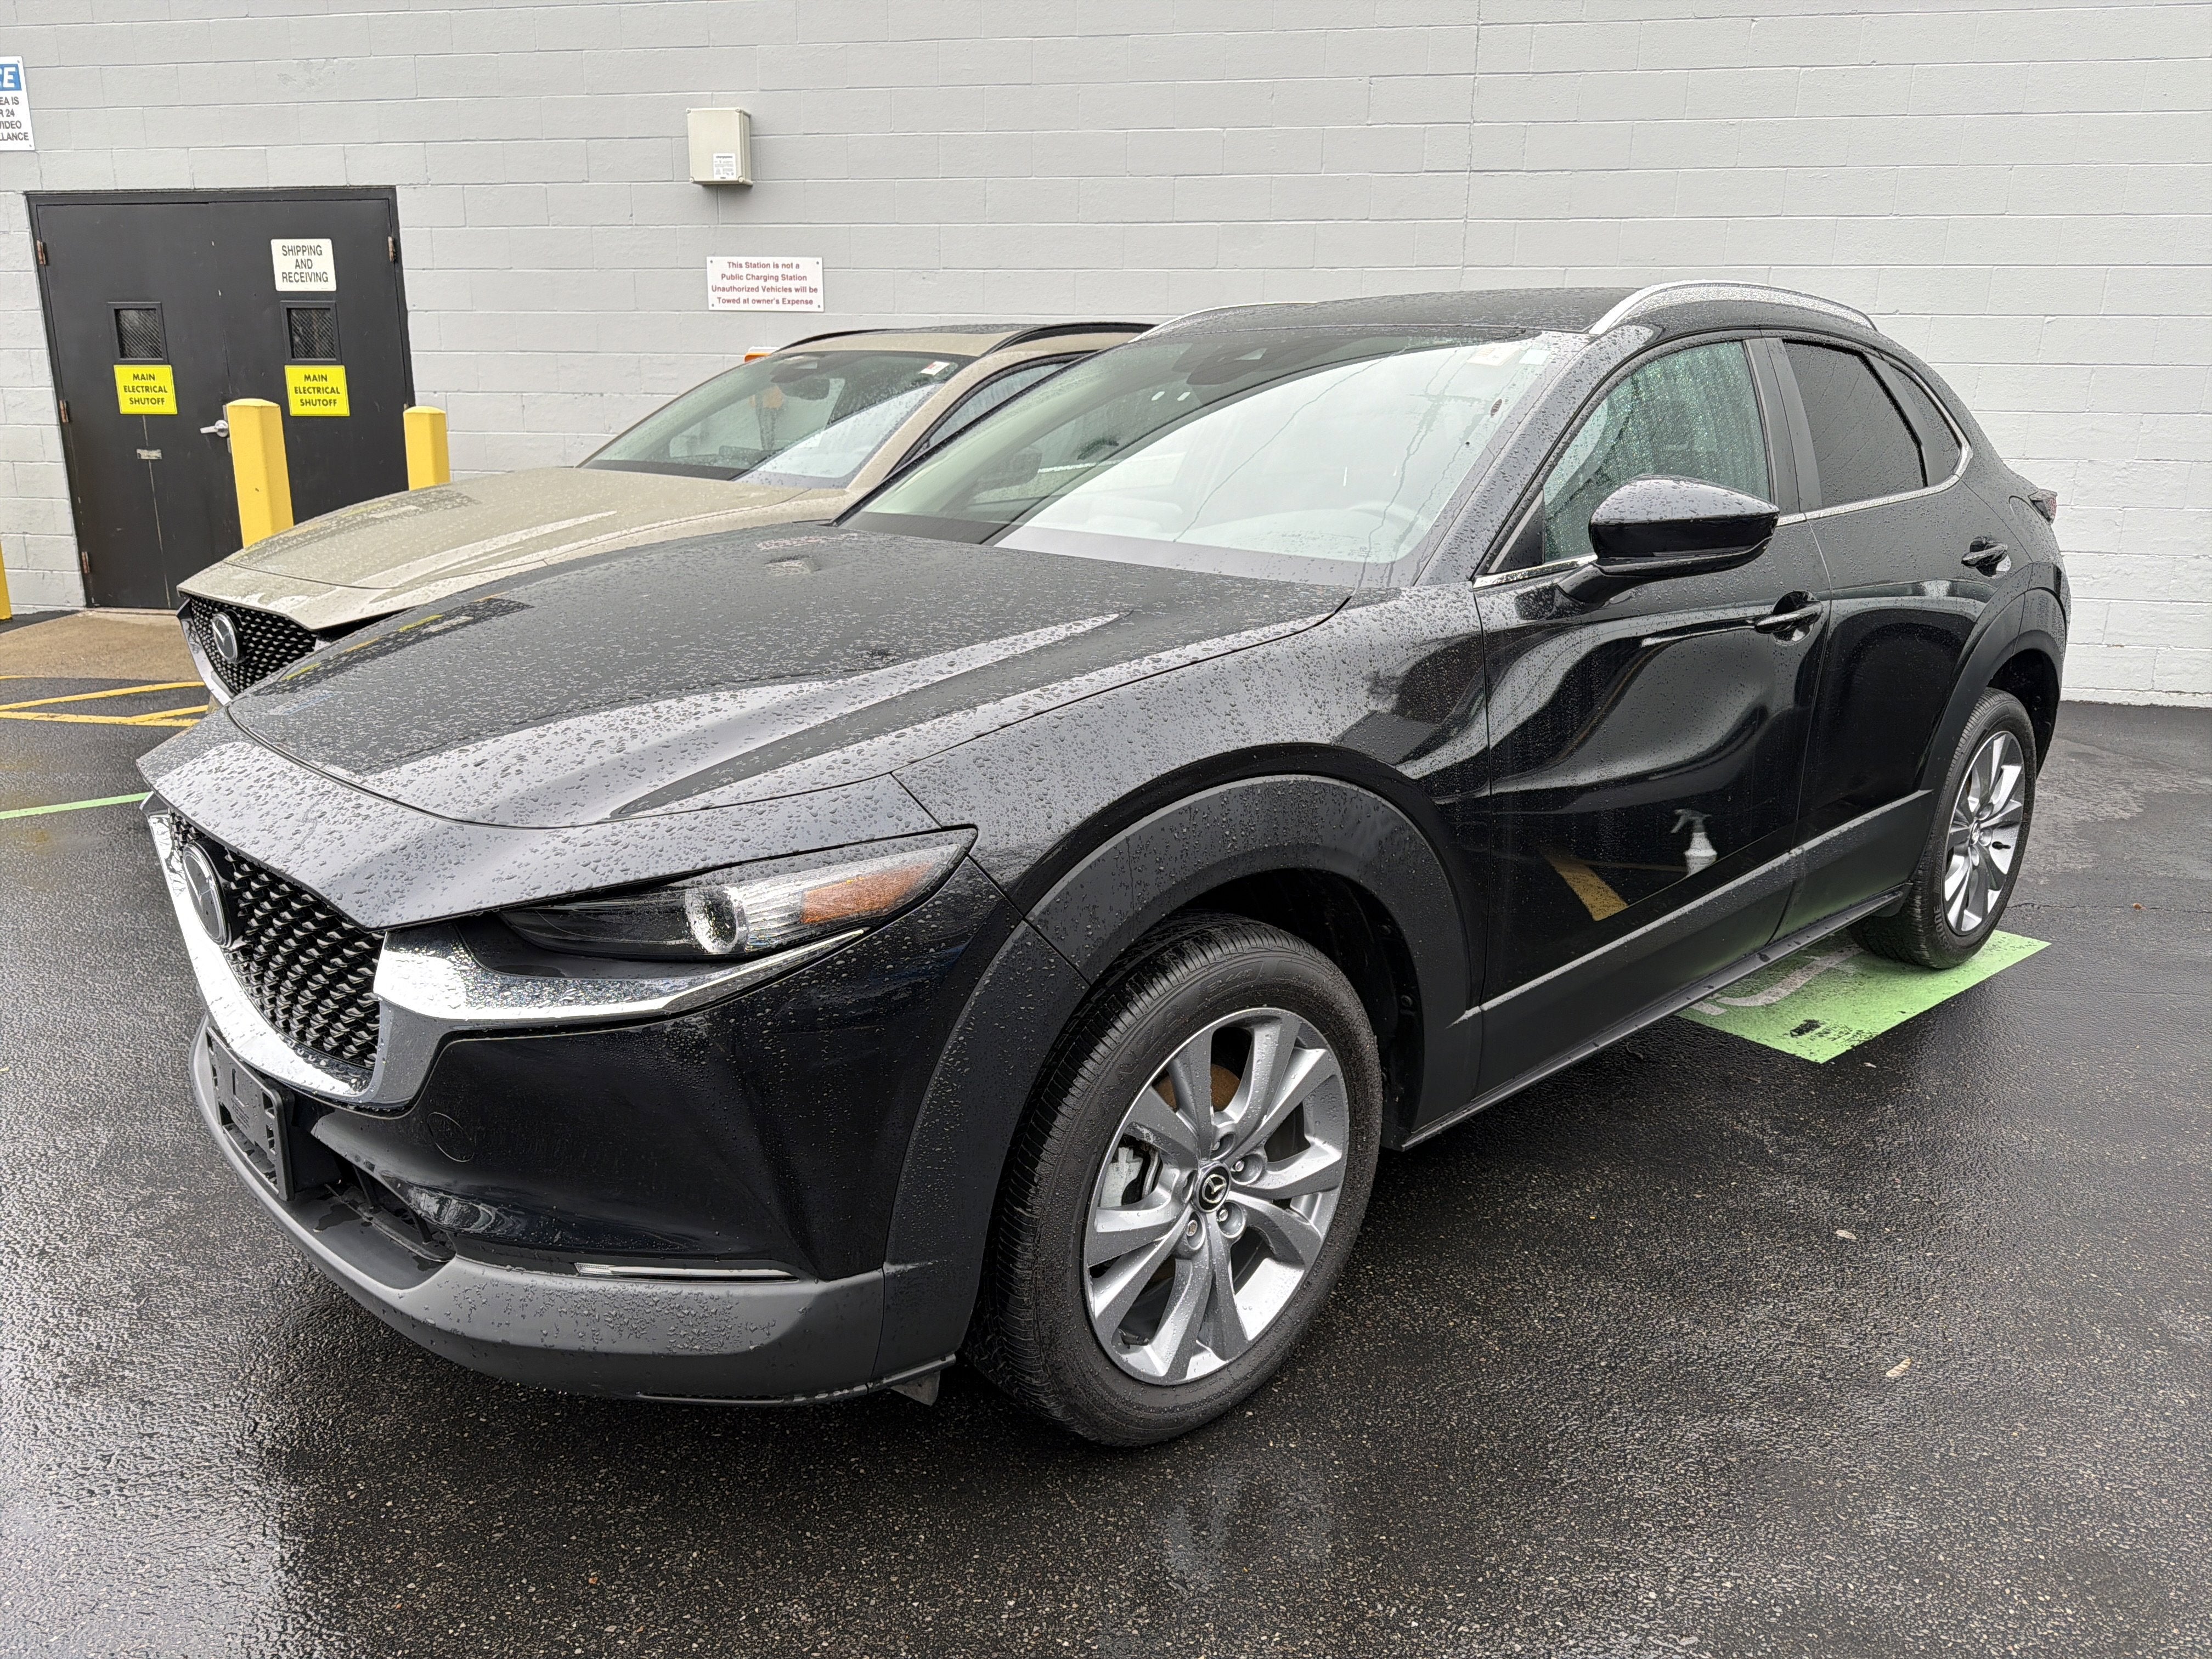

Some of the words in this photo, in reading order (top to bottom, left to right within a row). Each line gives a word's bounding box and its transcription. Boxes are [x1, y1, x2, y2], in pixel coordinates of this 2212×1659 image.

[11, 96, 20, 105] IS
[5, 108, 15, 117] 24
[281, 245, 323, 256] SHIPPING
[295, 258, 313, 269] AND
[281, 272, 329, 283] RECEIVING
[746, 274, 779, 283] Charging
[782, 298, 813, 306] Expense
[132, 373, 155, 381] MAIN
[304, 374, 328, 382] MAIN
[123, 385, 168, 393] ELECTRICAL
[294, 386, 340, 394] ELECTRICAL
[300, 398, 337, 407] SHUTOFF
